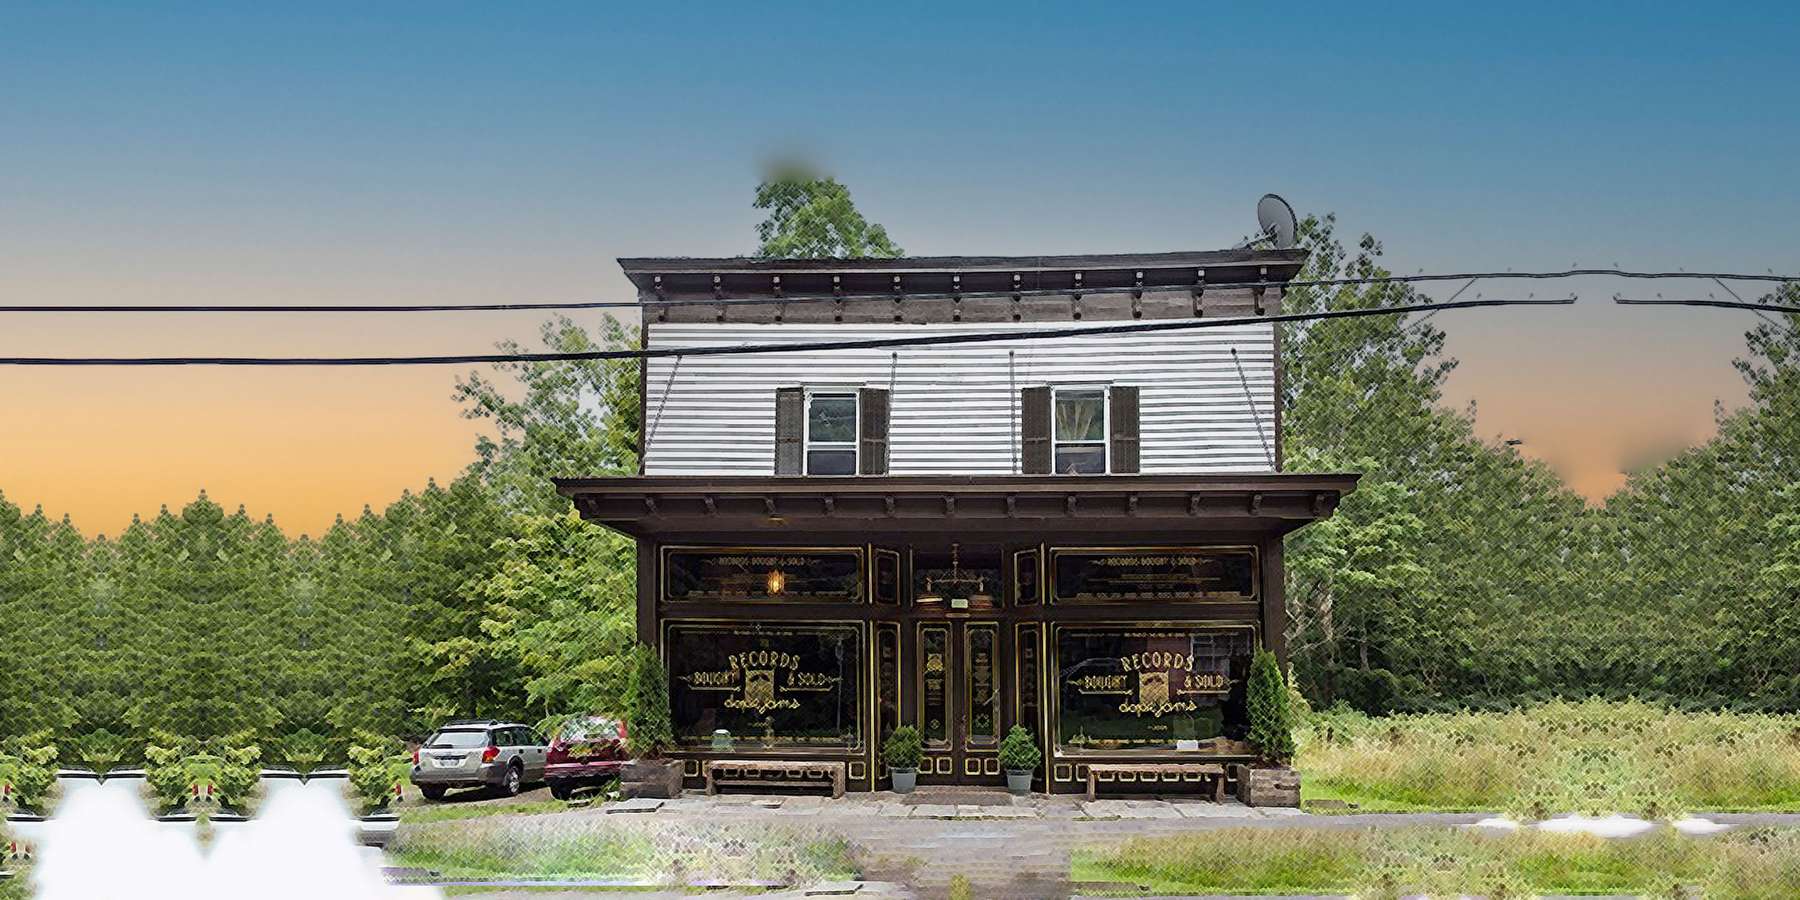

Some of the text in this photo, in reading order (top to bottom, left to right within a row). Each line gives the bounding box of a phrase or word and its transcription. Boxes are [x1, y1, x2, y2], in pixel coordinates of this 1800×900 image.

[728, 650, 800, 671] RECORDS
[1120, 651, 1195, 672] RECORDS
[694, 671, 826, 686] BOUGHT & SOLD
[1084, 674, 1224, 688] BOUGHT & SOLD
